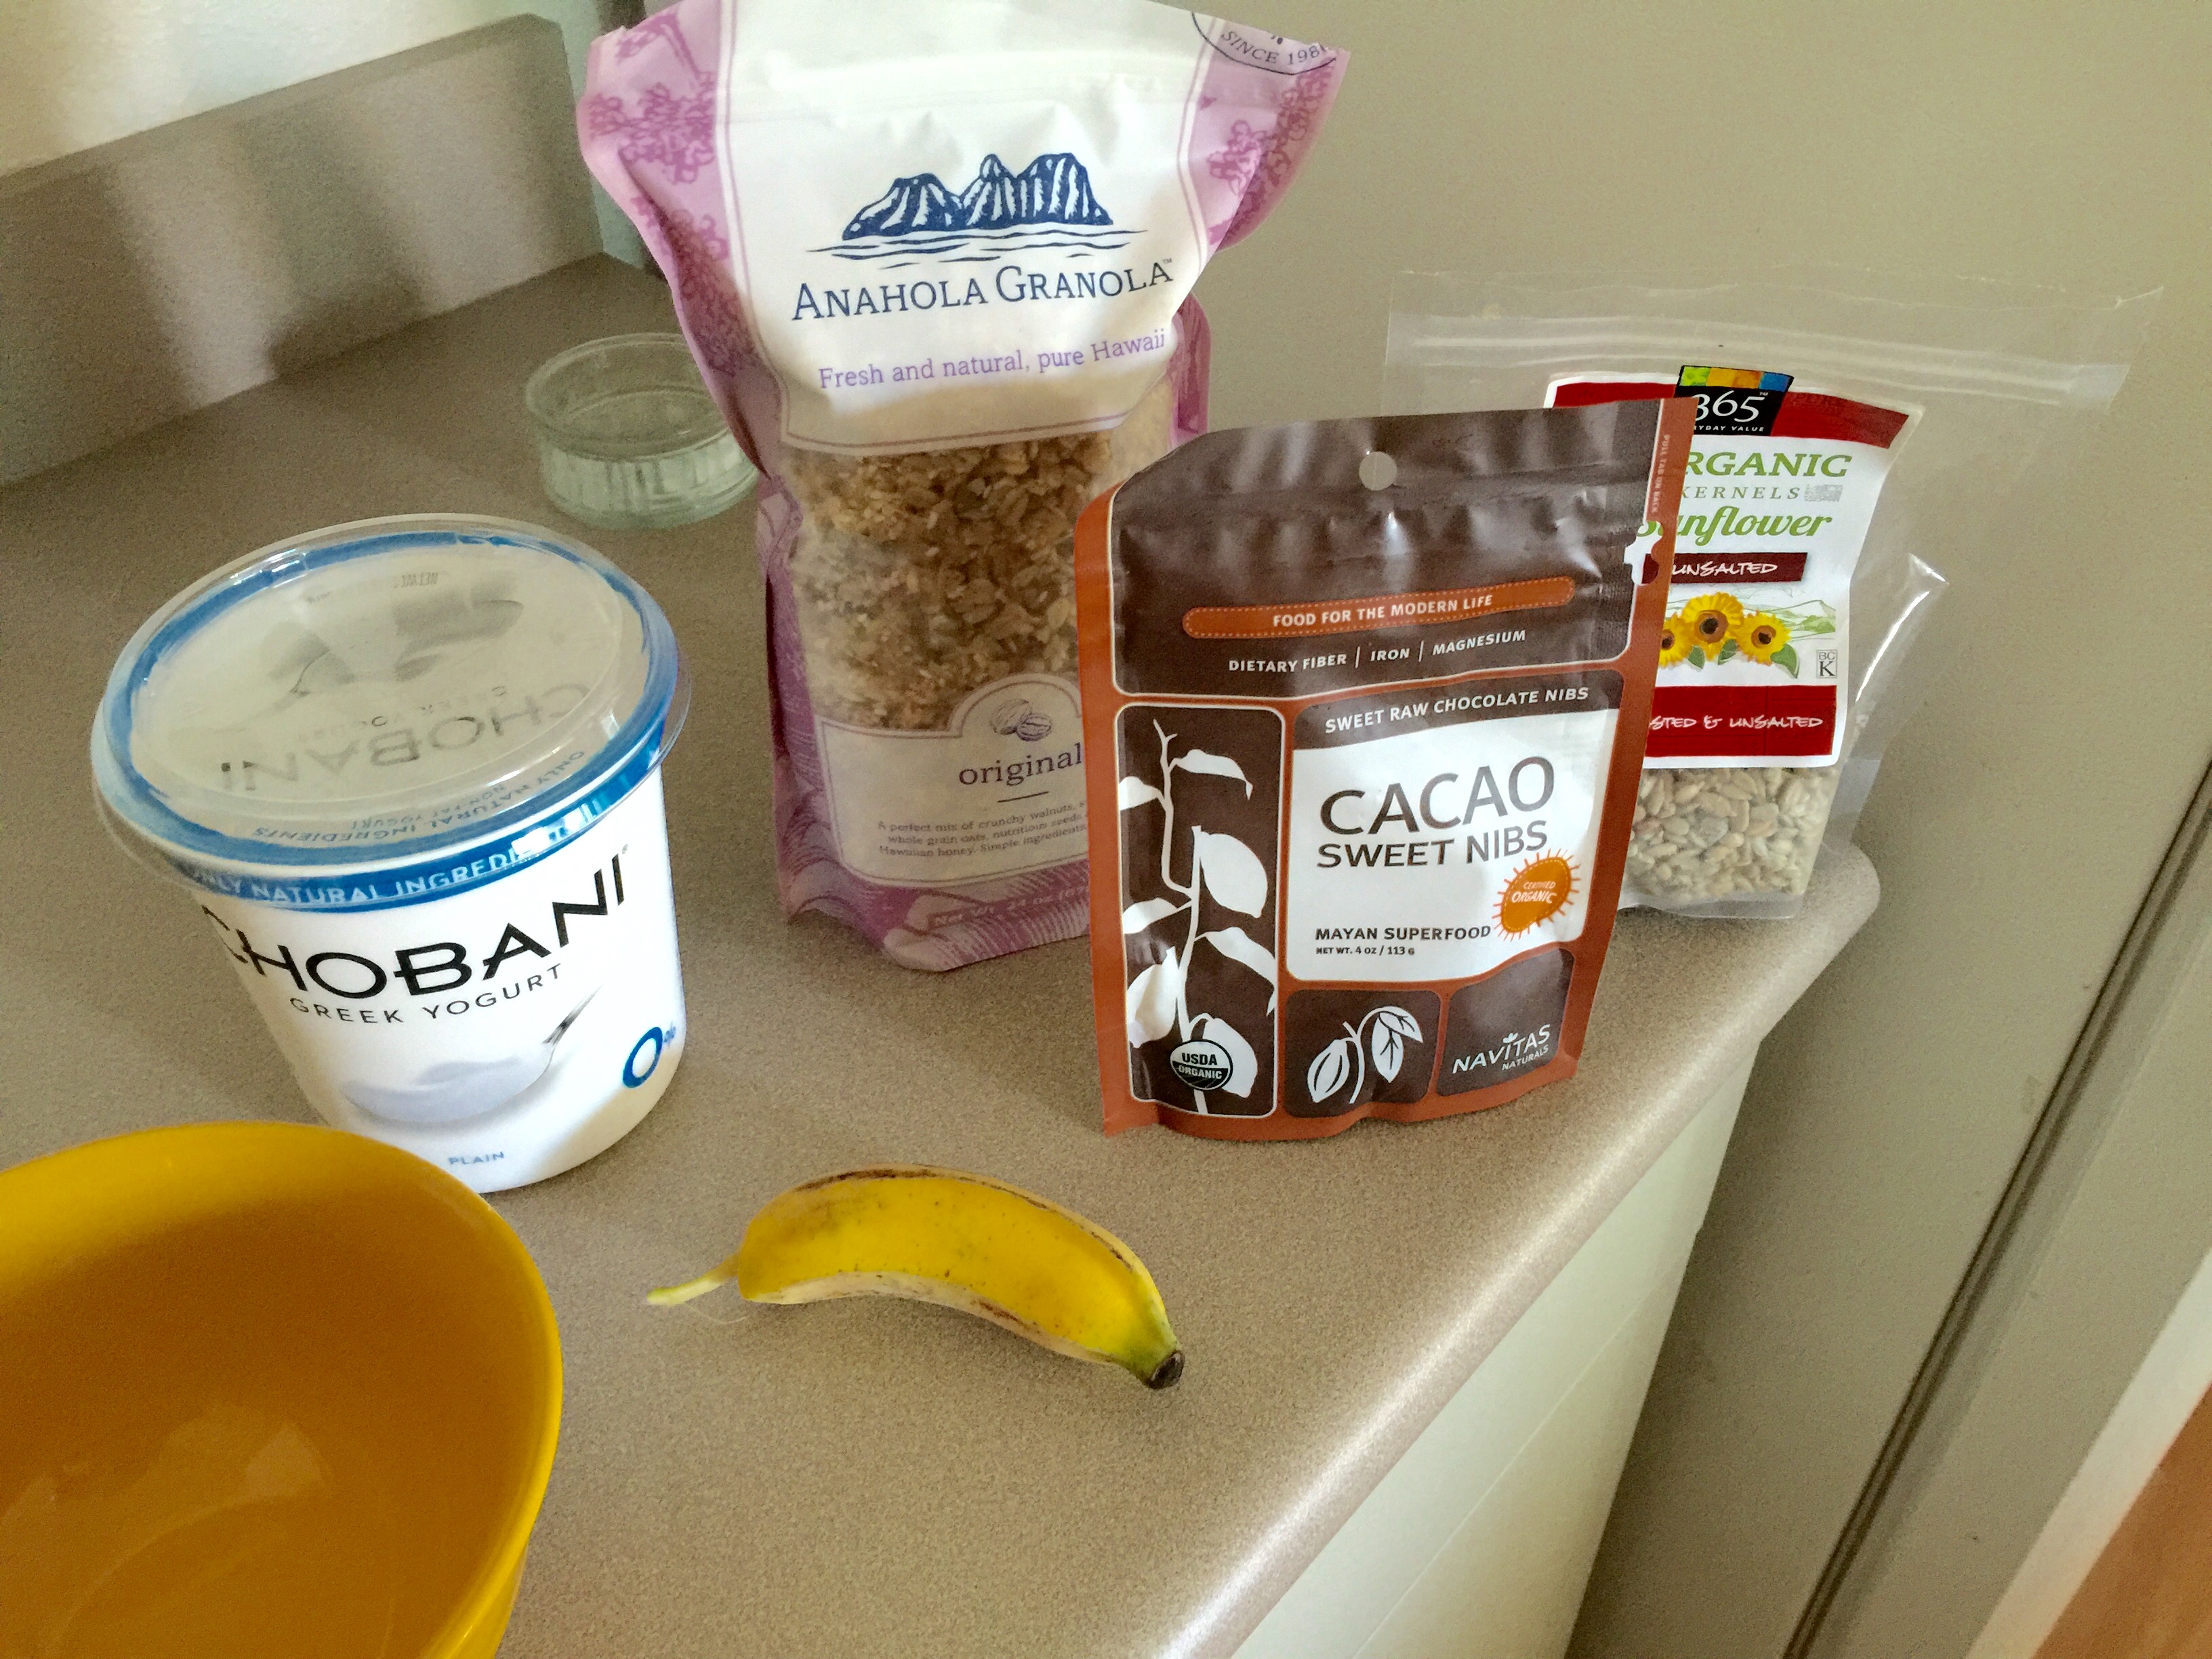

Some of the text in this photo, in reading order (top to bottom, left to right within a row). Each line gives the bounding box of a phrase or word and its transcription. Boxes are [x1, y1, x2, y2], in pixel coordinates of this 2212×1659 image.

[1221, 30, 1279, 64] SINCE
[792, 278, 988, 321] ANAHOLA
[996, 262, 1173, 303] GRANOLA
[819, 328, 1166, 389] Fresh and natural, pure Hawaii
[1692, 390, 1765, 423] 365
[1686, 451, 1853, 477] RGANIC
[1681, 486, 1800, 499] KERNELS
[1672, 562, 1778, 577] UNSALTED
[1273, 595, 1493, 627] FOOD FOR THE MODERN LIFE
[1229, 630, 1526, 672] DIETARY FIBER IRON MAGNESIUM
[1820, 661, 1835, 676] K
[1325, 687, 1589, 734] SWEET RAW CHOCOLATE NIBS
[1649, 715, 1823, 731] STED & UNSALTED
[221, 683, 589, 791] CHOBANI
[959, 742, 1082, 786] original
[1319, 756, 1555, 835] CACAO
[961, 820, 975, 830] of
[979, 815, 1026, 829] crunchy
[1317, 819, 1547, 868] SWEET NIBS
[251, 883, 382, 905] NATURAL
[395, 828, 566, 897] INGREDI
[1512, 890, 1557, 903] ORGANIC
[1315, 925, 1491, 941] MAYAN SUPERFOOD
[1387, 946, 1406, 955] 113
[289, 962, 562, 1025] GREEK YOGURT
[1181, 1052, 1218, 1066] USDA
[1452, 1024, 1551, 1074] NAVITAS
[1502, 1044, 1549, 1071] NATURALS
[1178, 1065, 1223, 1080] ORGANIC
[449, 1151, 504, 1165] PLAIN
